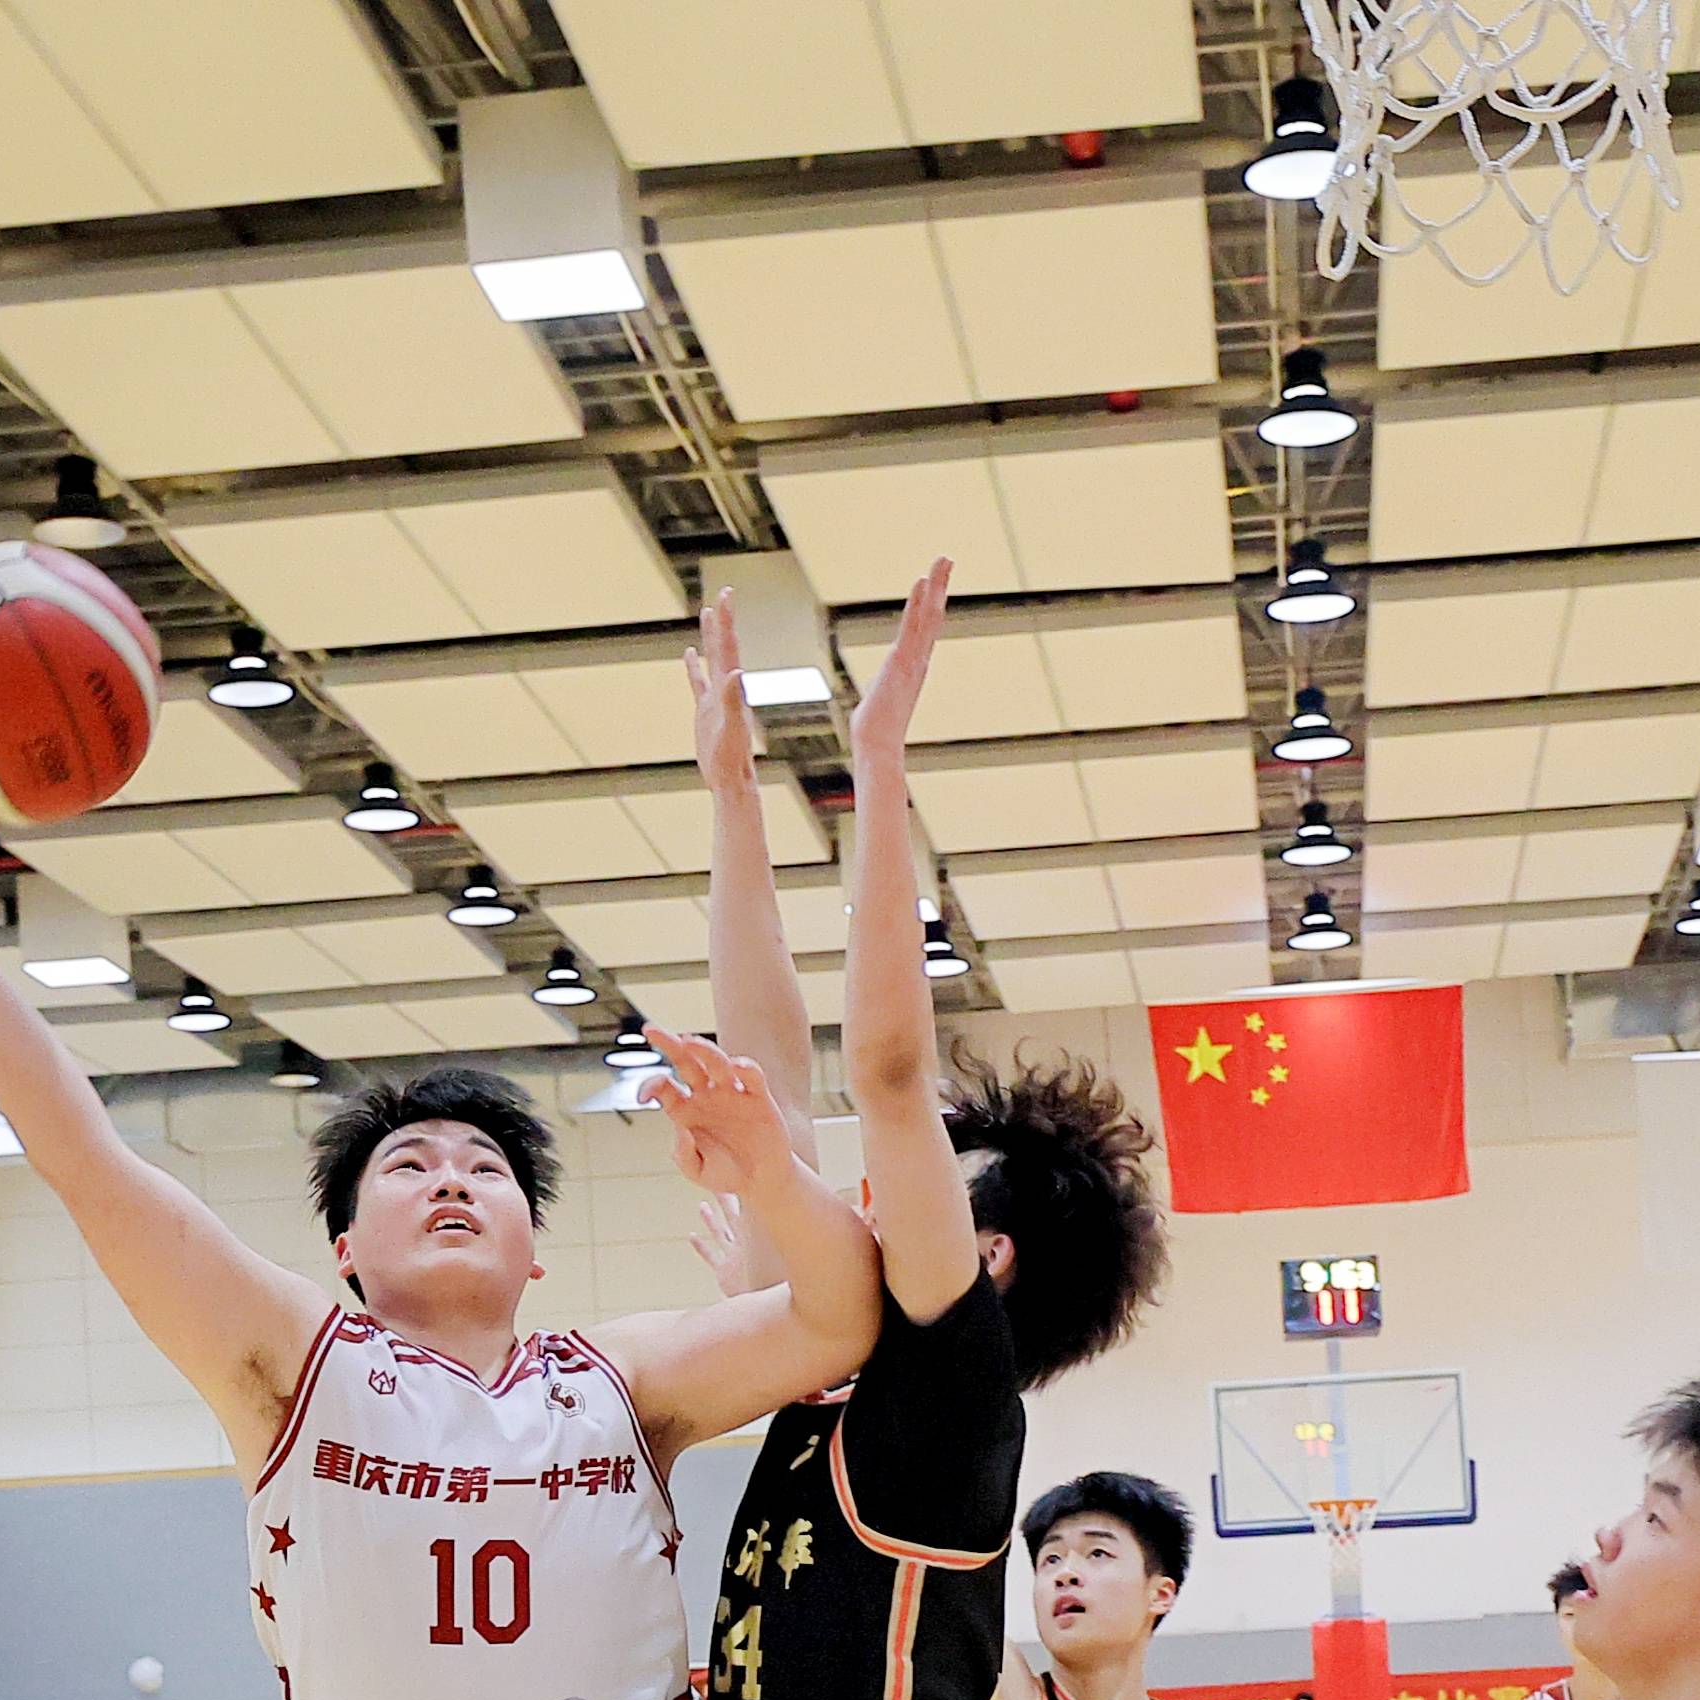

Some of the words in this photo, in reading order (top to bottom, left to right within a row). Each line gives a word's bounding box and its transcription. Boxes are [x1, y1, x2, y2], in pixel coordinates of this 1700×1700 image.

[1317, 1289, 1361, 1326] 11
[313, 1438, 637, 1503] 重庆市第一中学校
[429, 1538, 531, 1645] 10
[714, 1596, 763, 1700] 34
